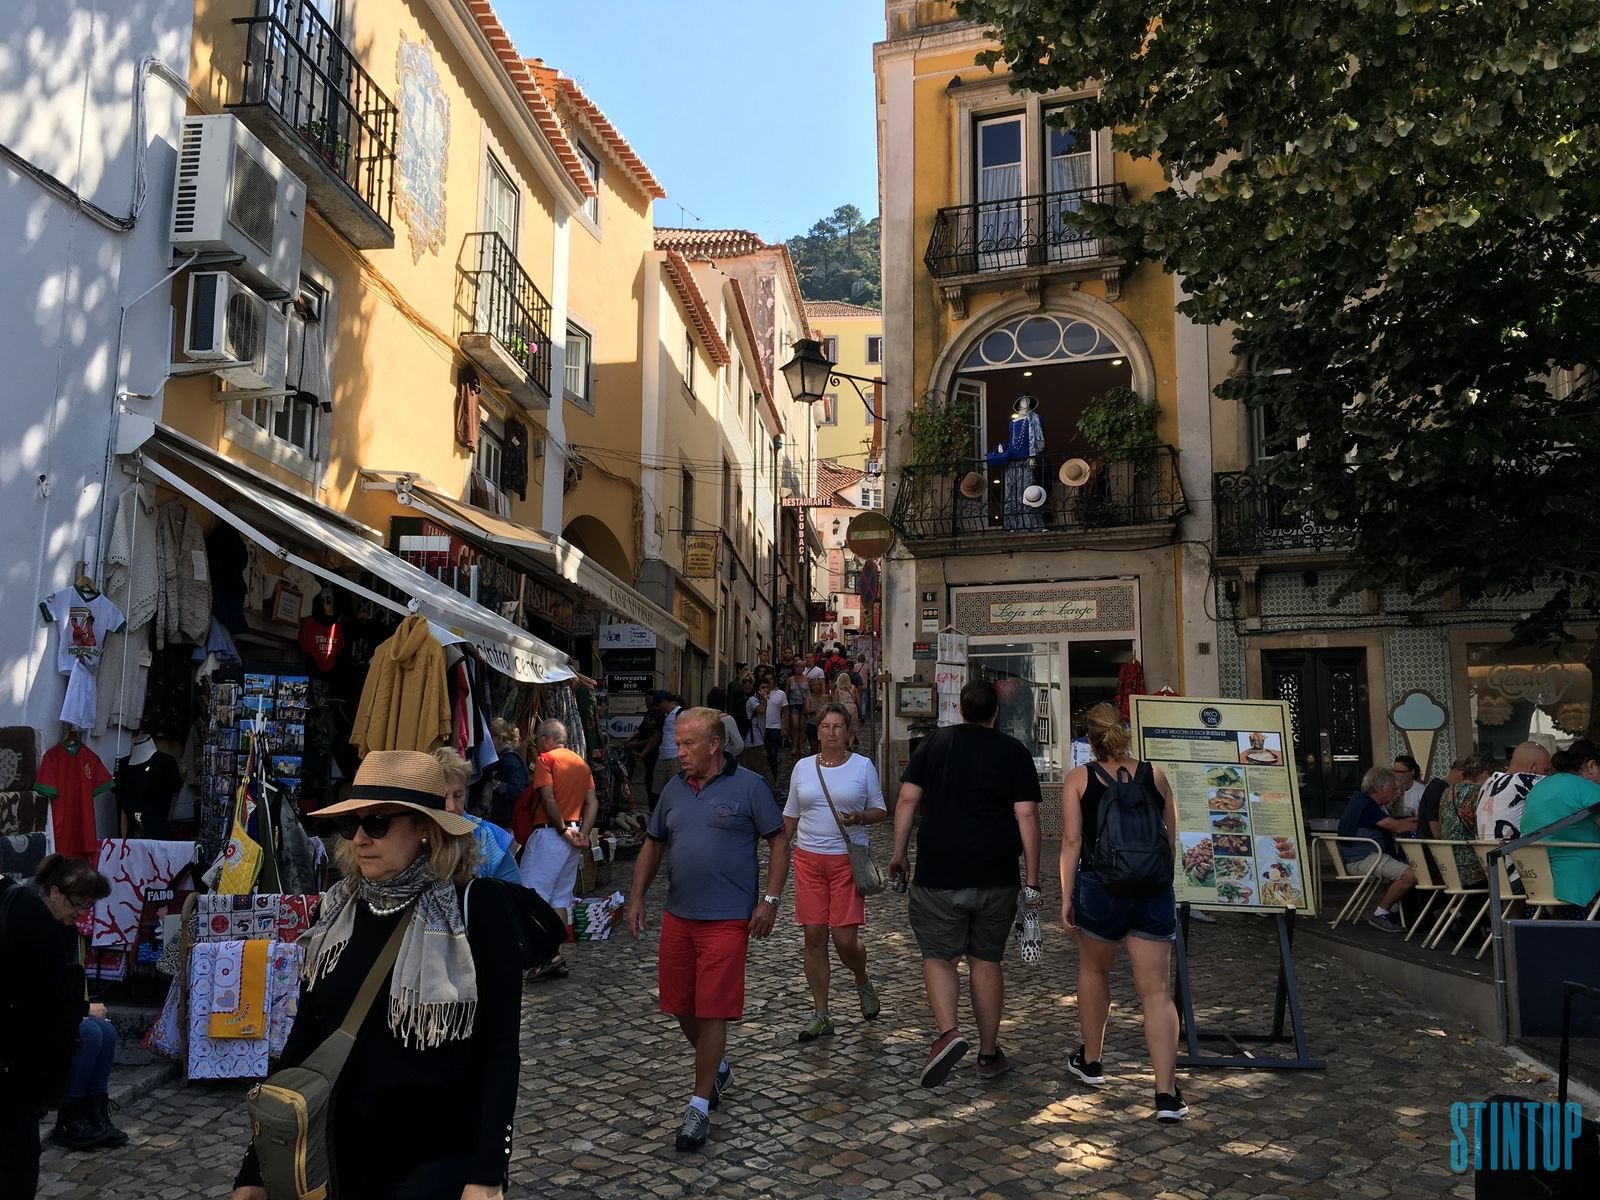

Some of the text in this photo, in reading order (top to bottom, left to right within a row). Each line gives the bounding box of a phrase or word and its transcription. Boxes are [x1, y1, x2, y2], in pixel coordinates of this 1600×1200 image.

[782, 497, 831, 507] RESTAURANTE
[926, 592, 932, 601] 6
[992, 603, 1026, 622] Loja
[1056, 601, 1094, 620] Largo
[147, 890, 174, 902] FADO
